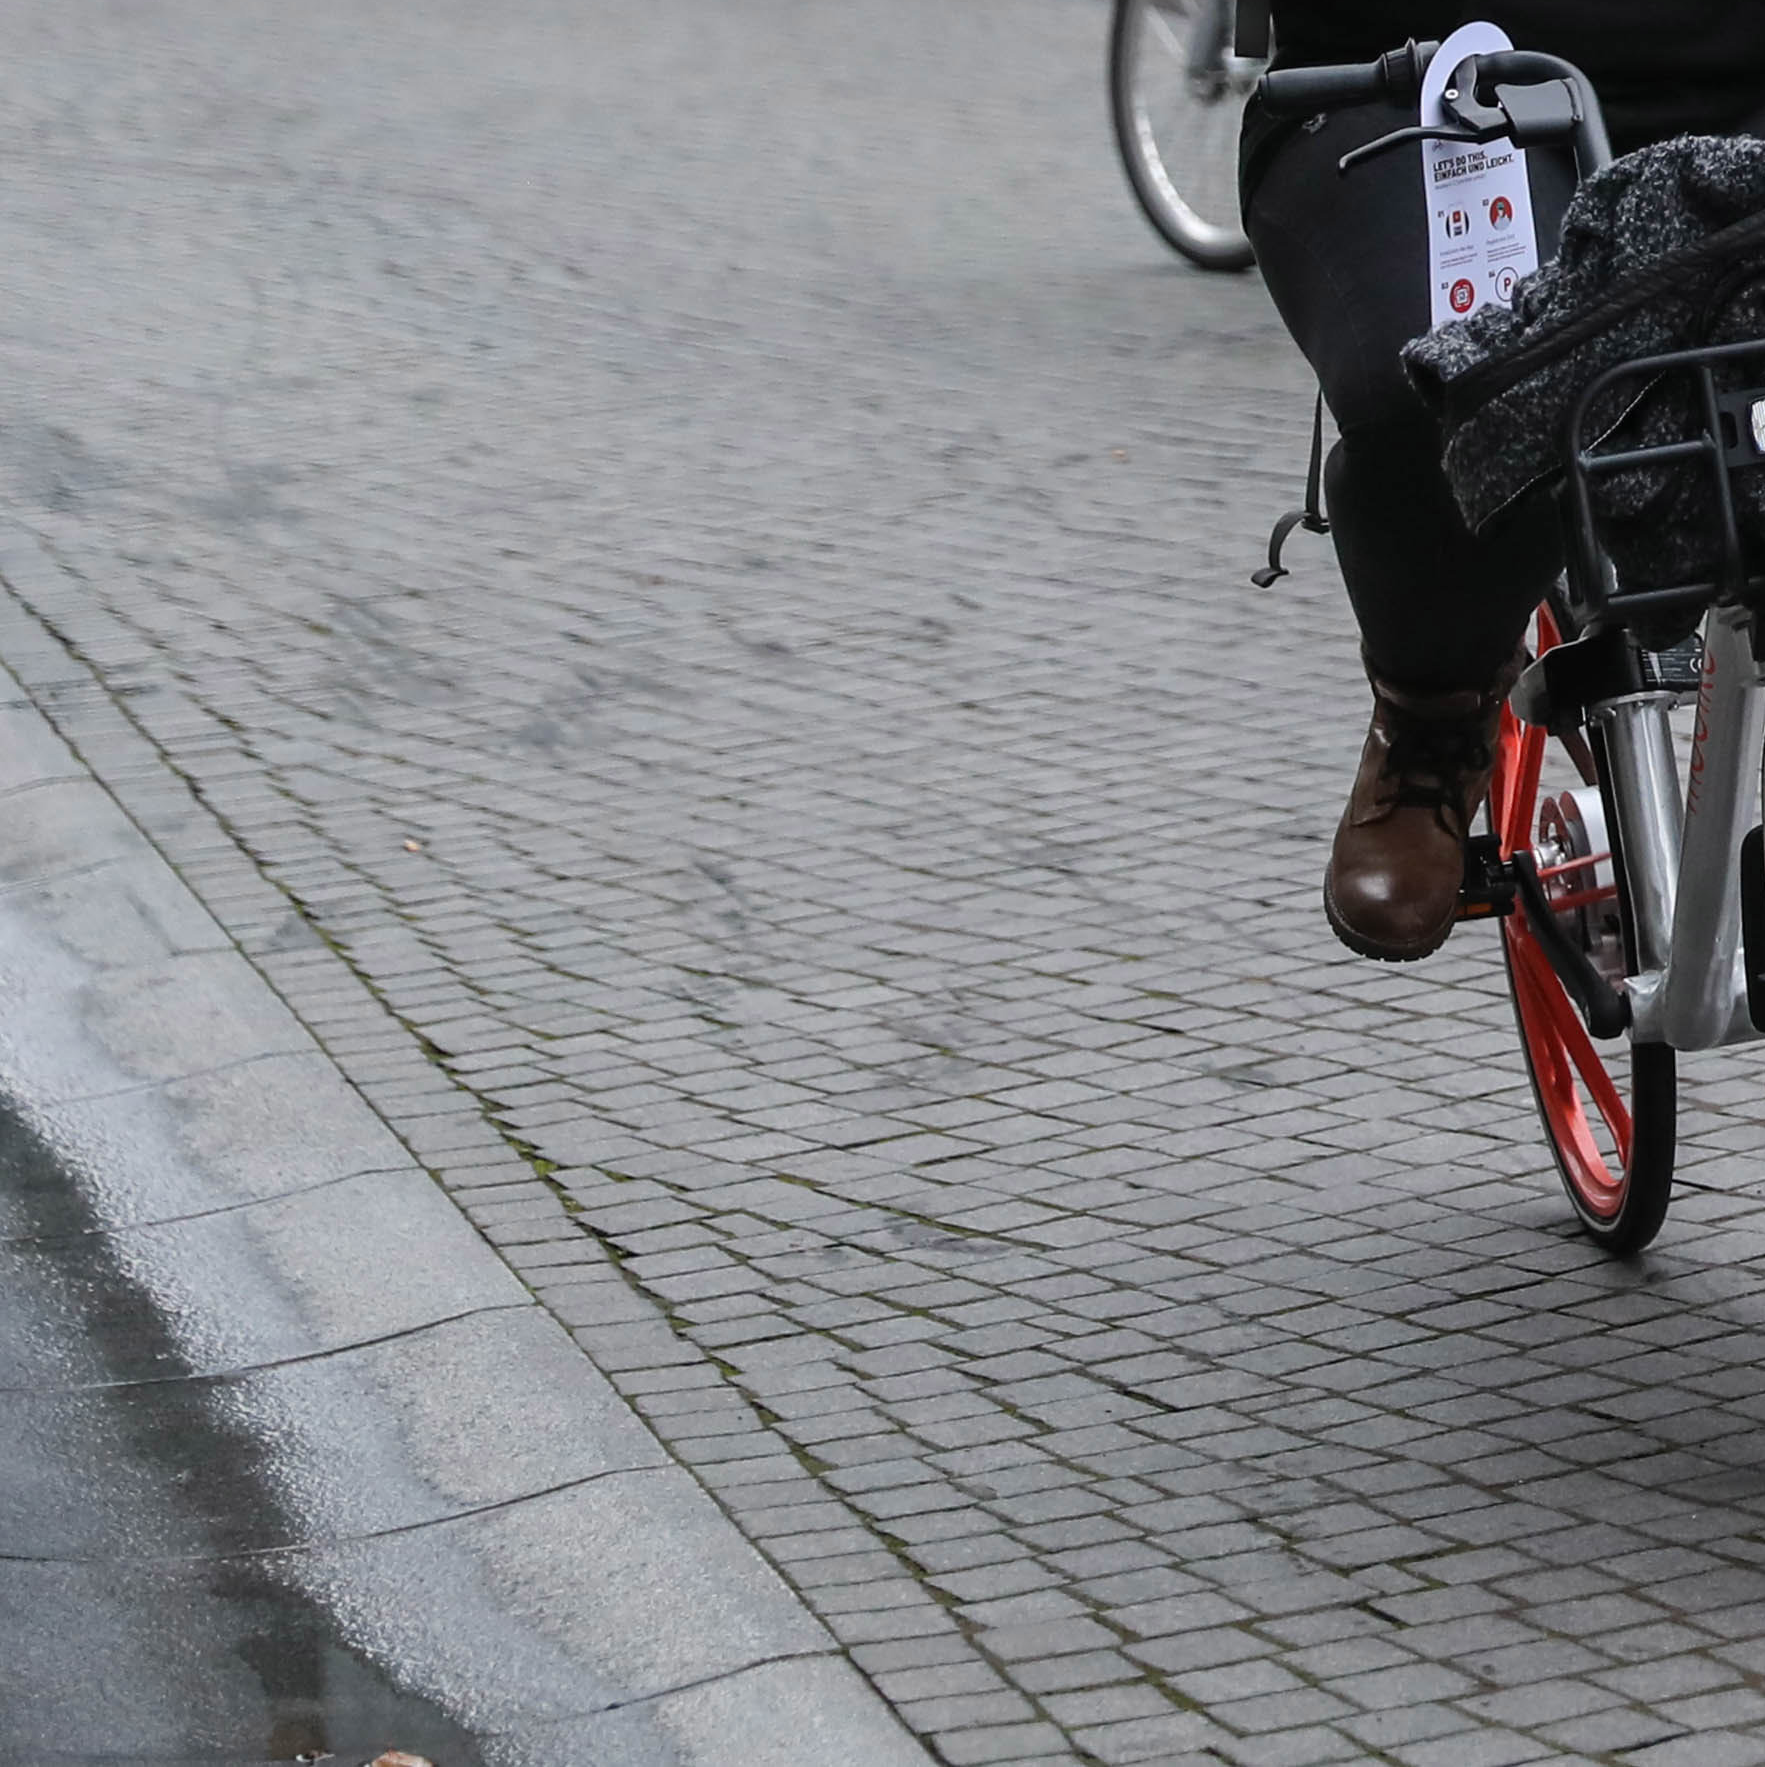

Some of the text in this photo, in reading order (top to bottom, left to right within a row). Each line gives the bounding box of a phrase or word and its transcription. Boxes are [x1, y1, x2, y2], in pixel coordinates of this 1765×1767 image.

[1433, 159, 1454, 172] LET'S
[1434, 166, 1467, 182] EINFACH
[1468, 161, 1484, 173] UND
